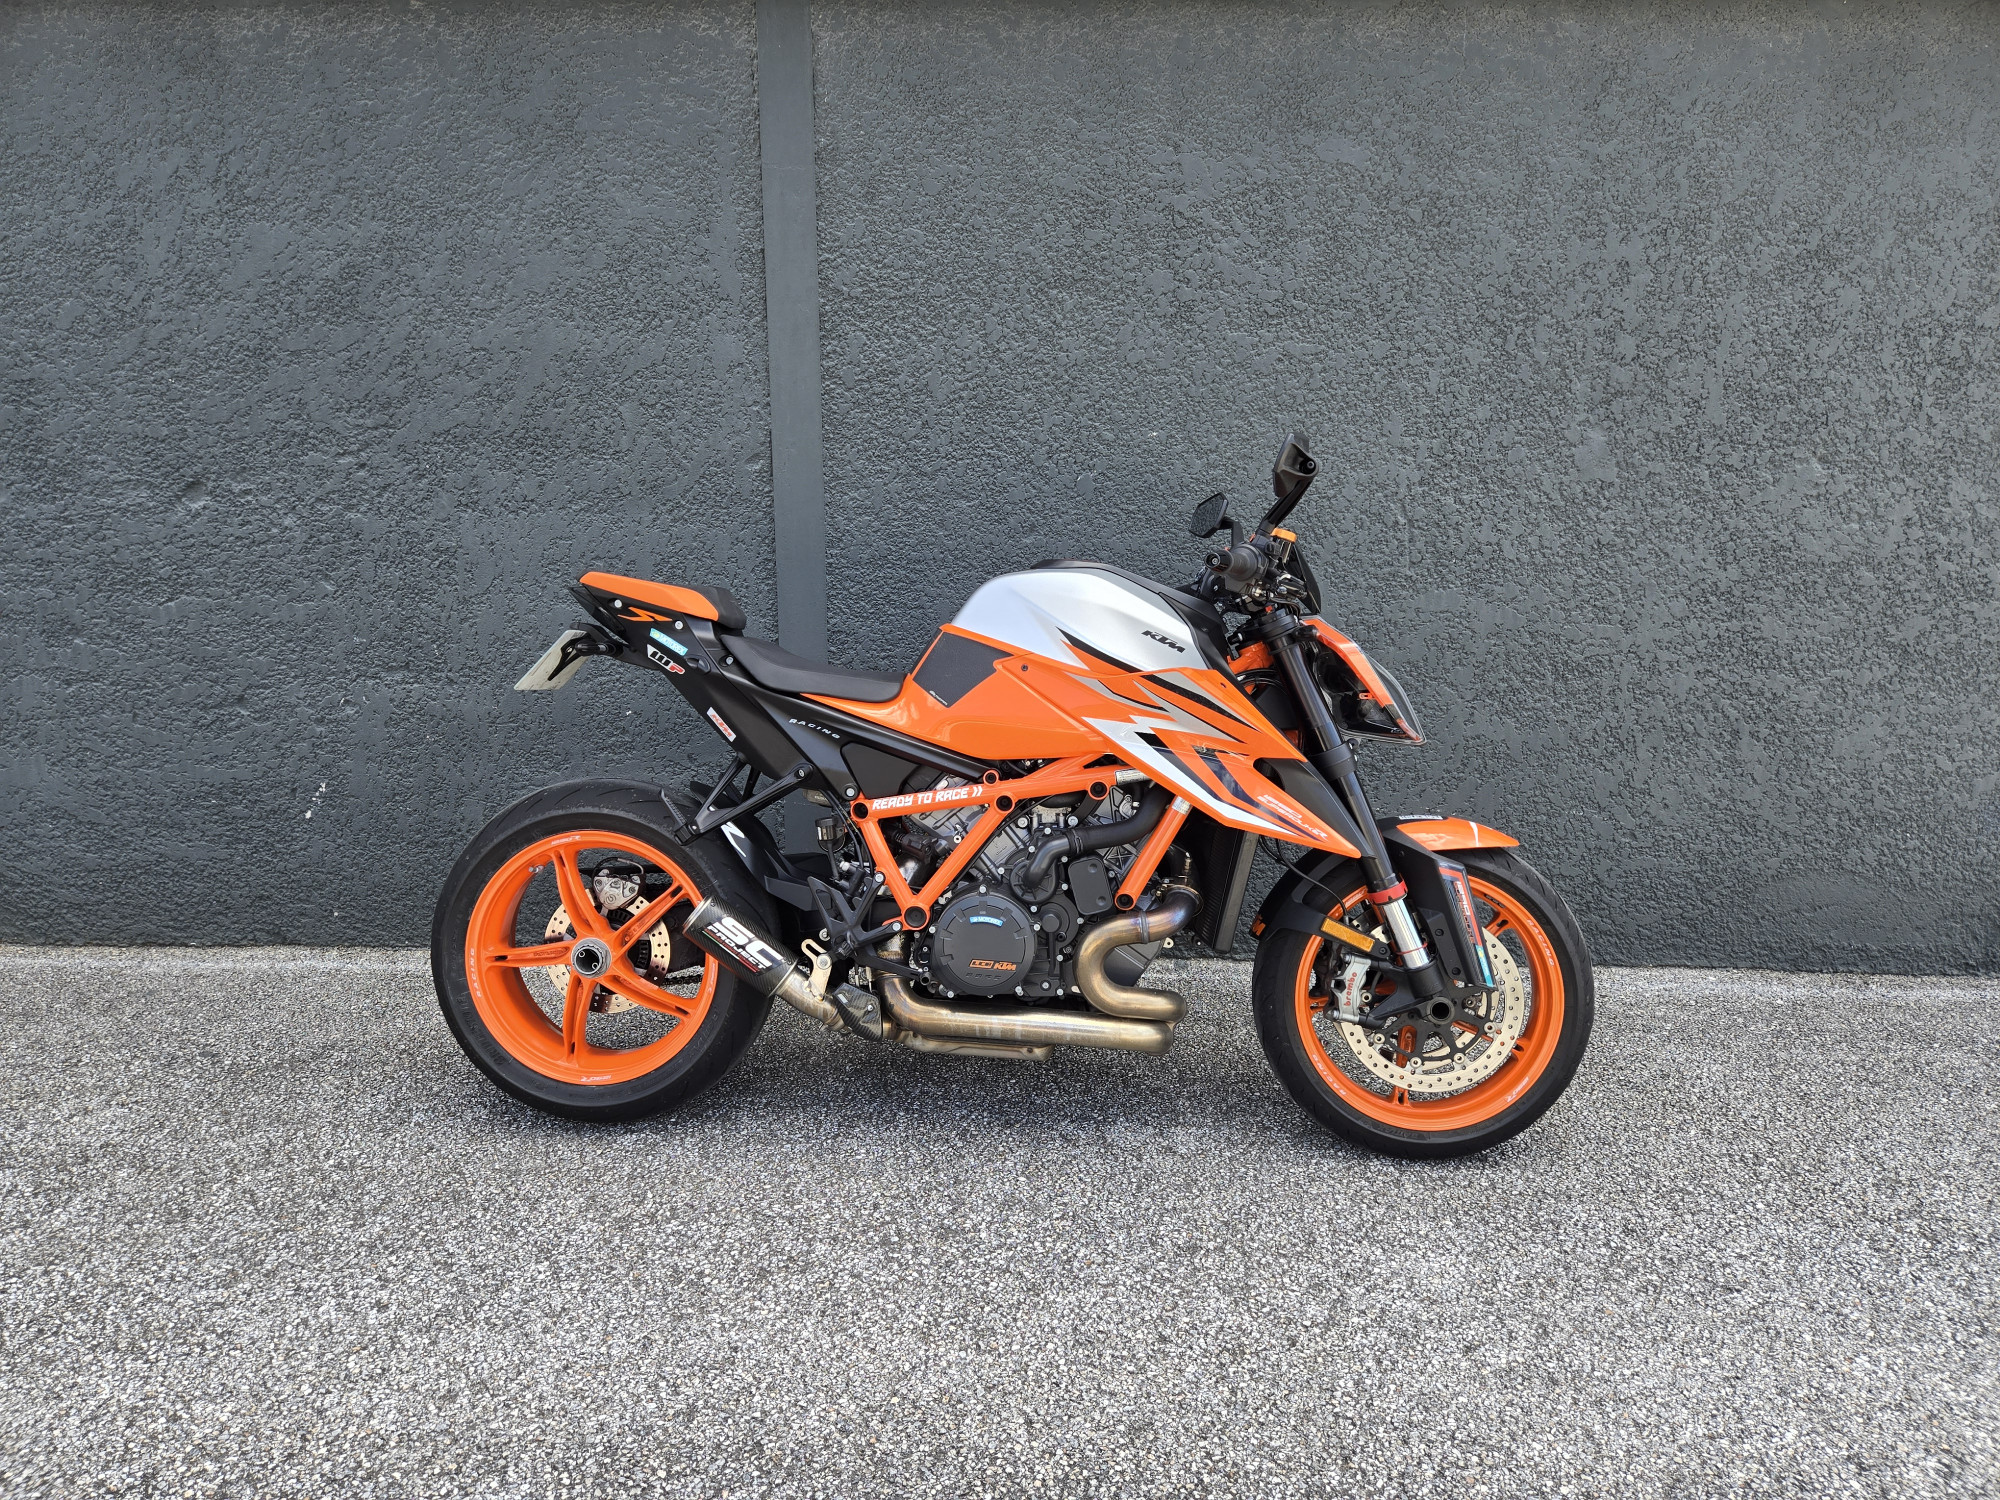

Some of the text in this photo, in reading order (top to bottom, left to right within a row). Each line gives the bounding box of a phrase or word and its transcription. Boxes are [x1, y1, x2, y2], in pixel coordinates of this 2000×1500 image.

[1141, 630, 1186, 653] KTM
[789, 718, 840, 739] RACING
[872, 787, 970, 810] READY TO RACE
[706, 925, 767, 969] PROJECT
[713, 916, 784, 968] SC
[1527, 919, 1555, 966] RACING
[470, 947, 482, 998] RACING
[993, 961, 1017, 971] KTM
[1343, 972, 1358, 1006] brembo
[1312, 1054, 1347, 1095] RACING
